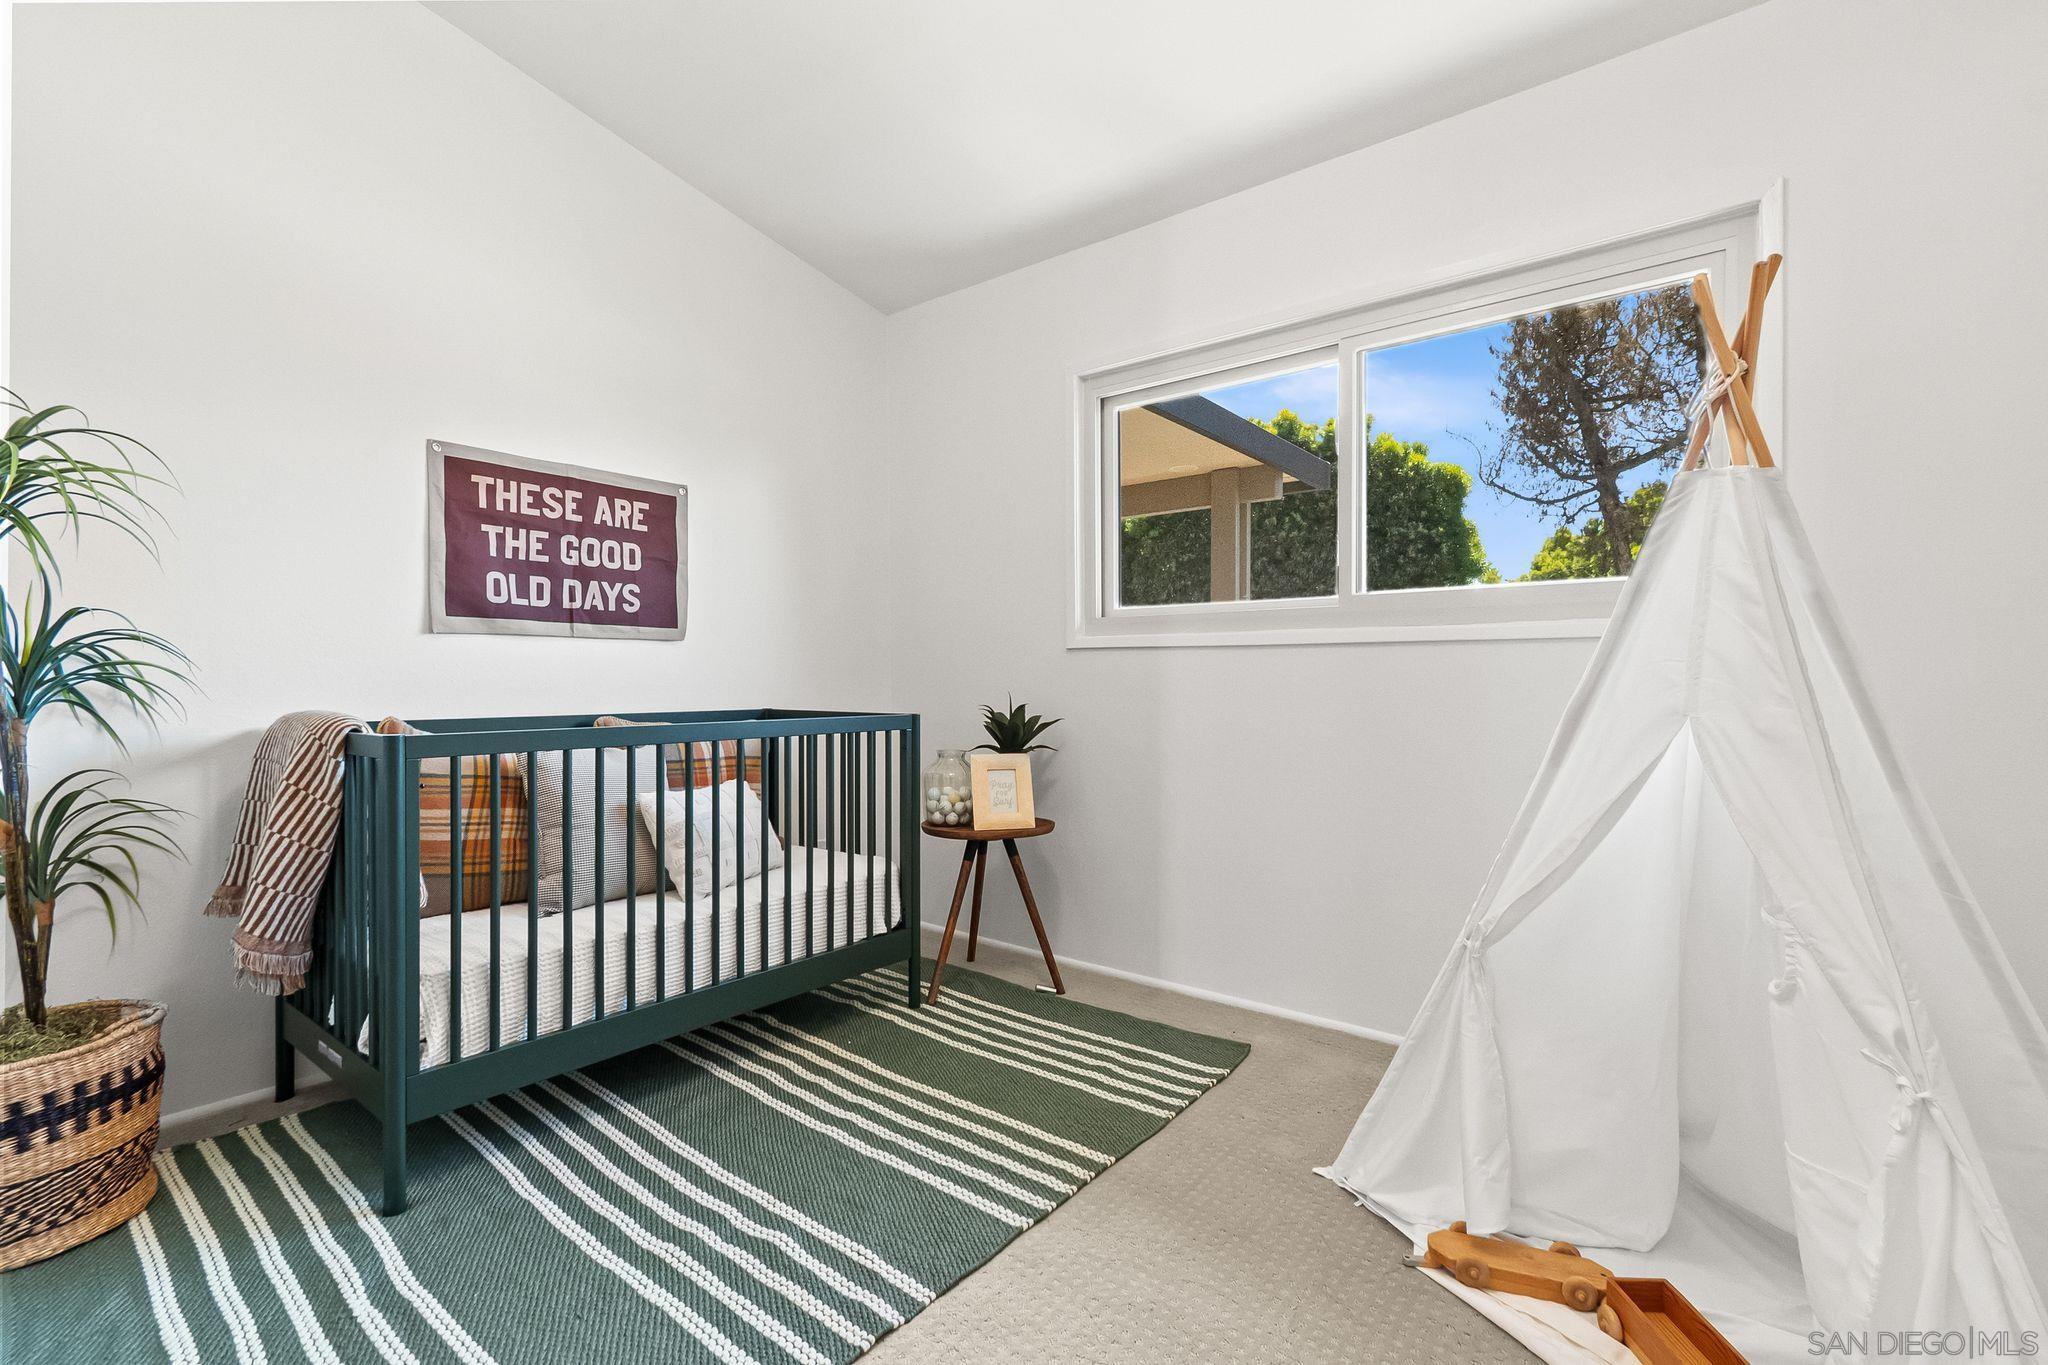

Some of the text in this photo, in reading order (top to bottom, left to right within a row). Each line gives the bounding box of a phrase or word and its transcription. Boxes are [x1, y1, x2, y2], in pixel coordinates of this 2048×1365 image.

[471, 474, 650, 532] THESE ARE
[480, 523, 642, 572] THE GOOD
[485, 571, 641, 614] OLD DAYS
